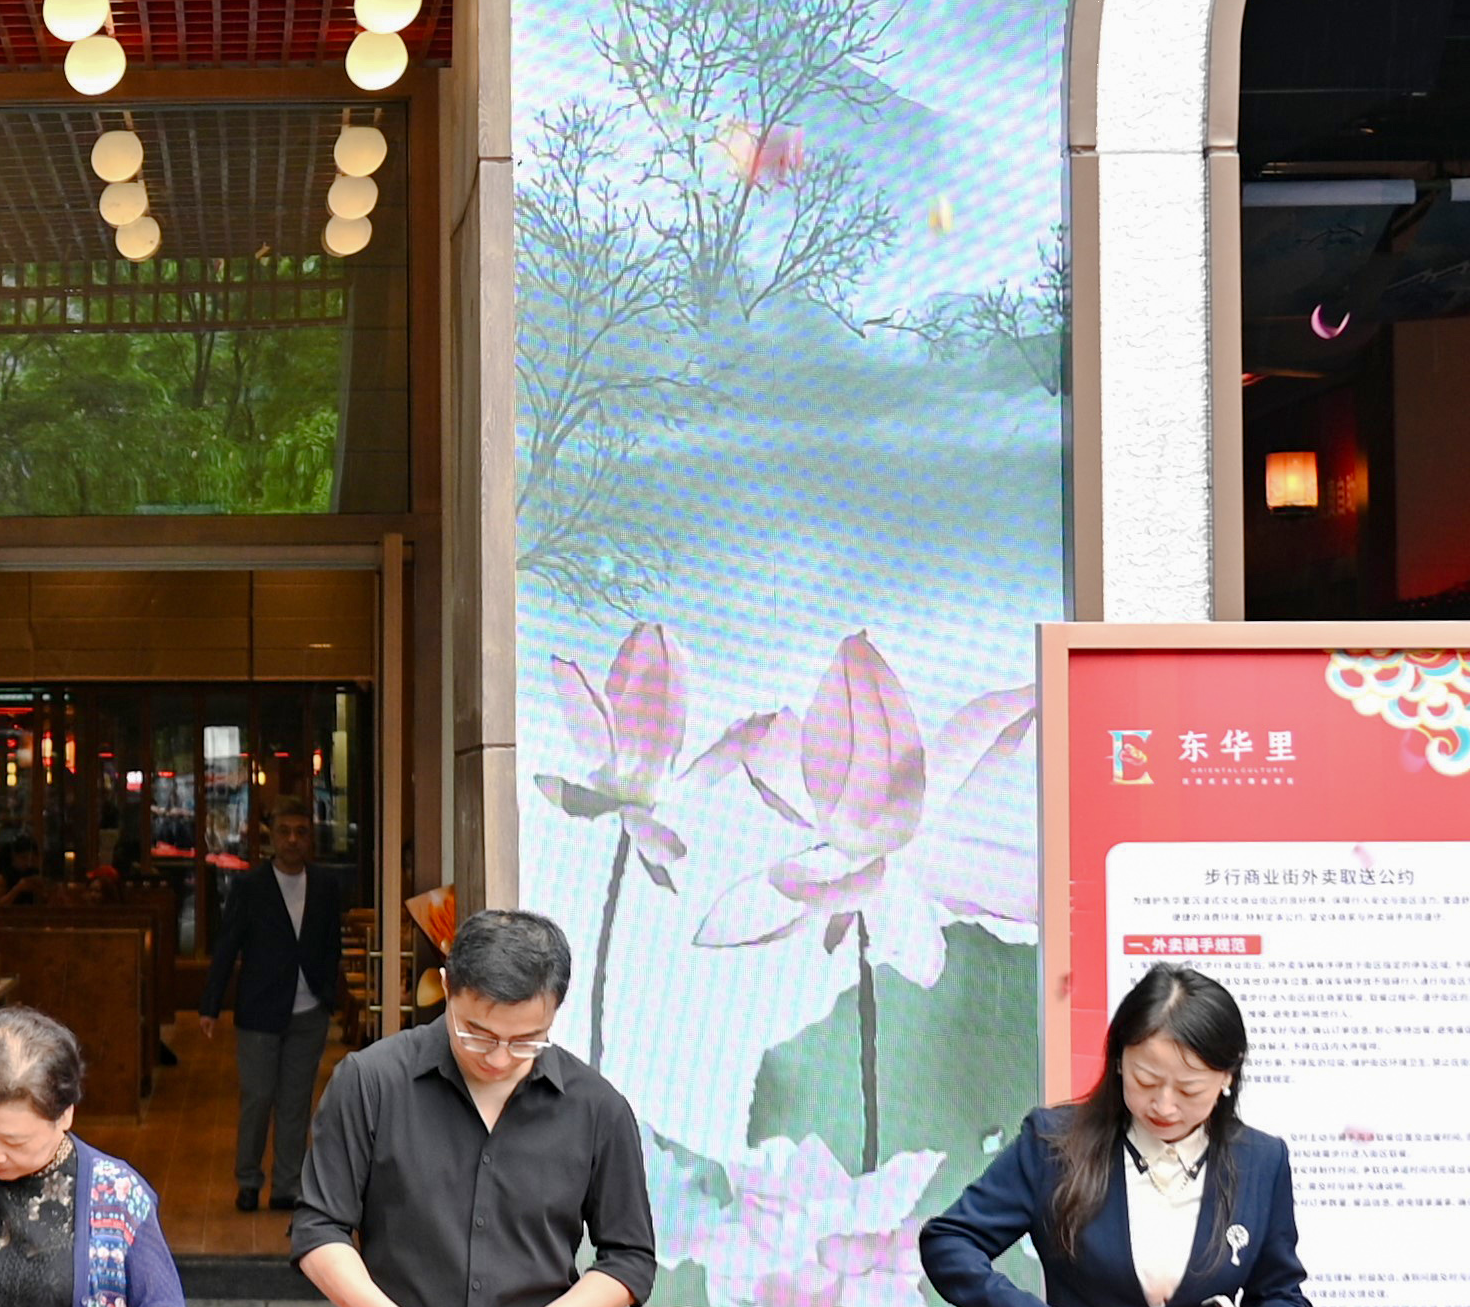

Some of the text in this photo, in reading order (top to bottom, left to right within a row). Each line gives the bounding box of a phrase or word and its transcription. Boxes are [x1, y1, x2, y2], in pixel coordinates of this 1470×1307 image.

[1178, 729, 1296, 763] 东华里
[1204, 868, 1414, 885] 步行商业街外卖取送公约
[1127, 937, 1247, 954] 一、外卖骑手规范
